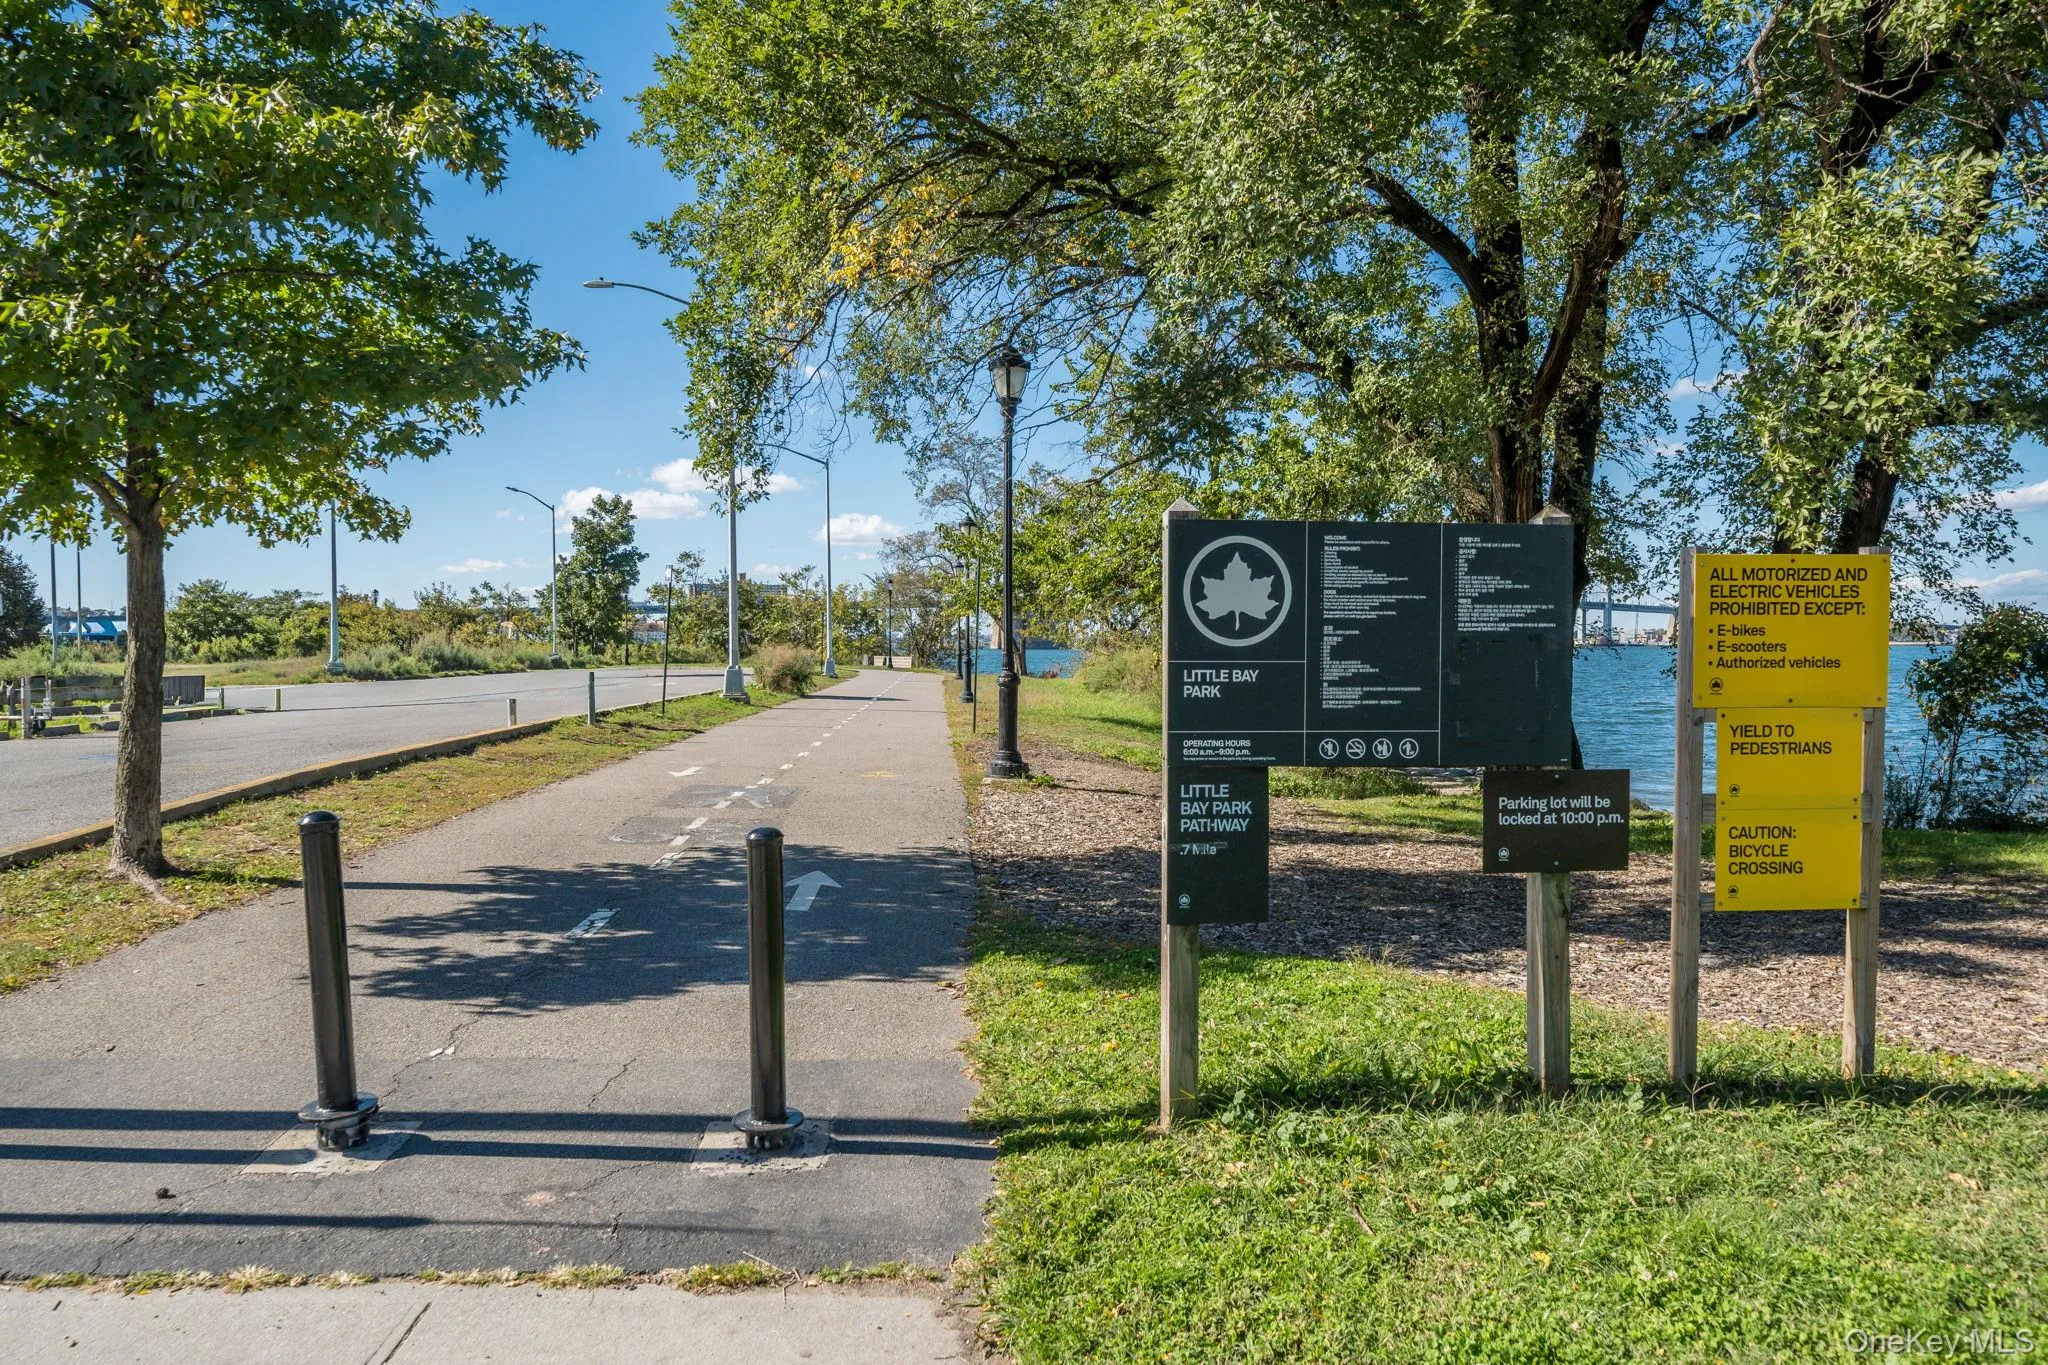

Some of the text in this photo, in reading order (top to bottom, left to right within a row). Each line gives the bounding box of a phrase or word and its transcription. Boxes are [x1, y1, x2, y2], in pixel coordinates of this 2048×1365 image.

[1709, 568, 1868, 581] ALL MOTORIZED AND
[1710, 585, 1860, 598] ELECTRIC VEHICLES
[1710, 602, 1866, 615] PROHIBITED EXCEPT:
[1717, 624, 1766, 637] E-bikes
[1717, 641, 1787, 653] E-scooters
[1716, 656, 1841, 669] Authorized vehicles
[1184, 670, 1259, 682] LITTLE BAY
[1184, 685, 1221, 698] PARK
[1729, 725, 1794, 738] YIELD TO
[1730, 741, 1832, 755] PEDESTRIANS
[1180, 784, 1229, 798] LITTLE
[1180, 801, 1252, 815] BAY PARK
[1499, 796, 1611, 812] Parking lot will be
[1180, 818, 1250, 832] PATHWAY
[1499, 812, 1624, 826] locked at 10:00 p.m.
[1729, 826, 1797, 839] CAUTION:
[1180, 844, 1190, 855] .7
[1729, 844, 1789, 858] BICYCLE
[1728, 861, 1803, 874] CROSSING
